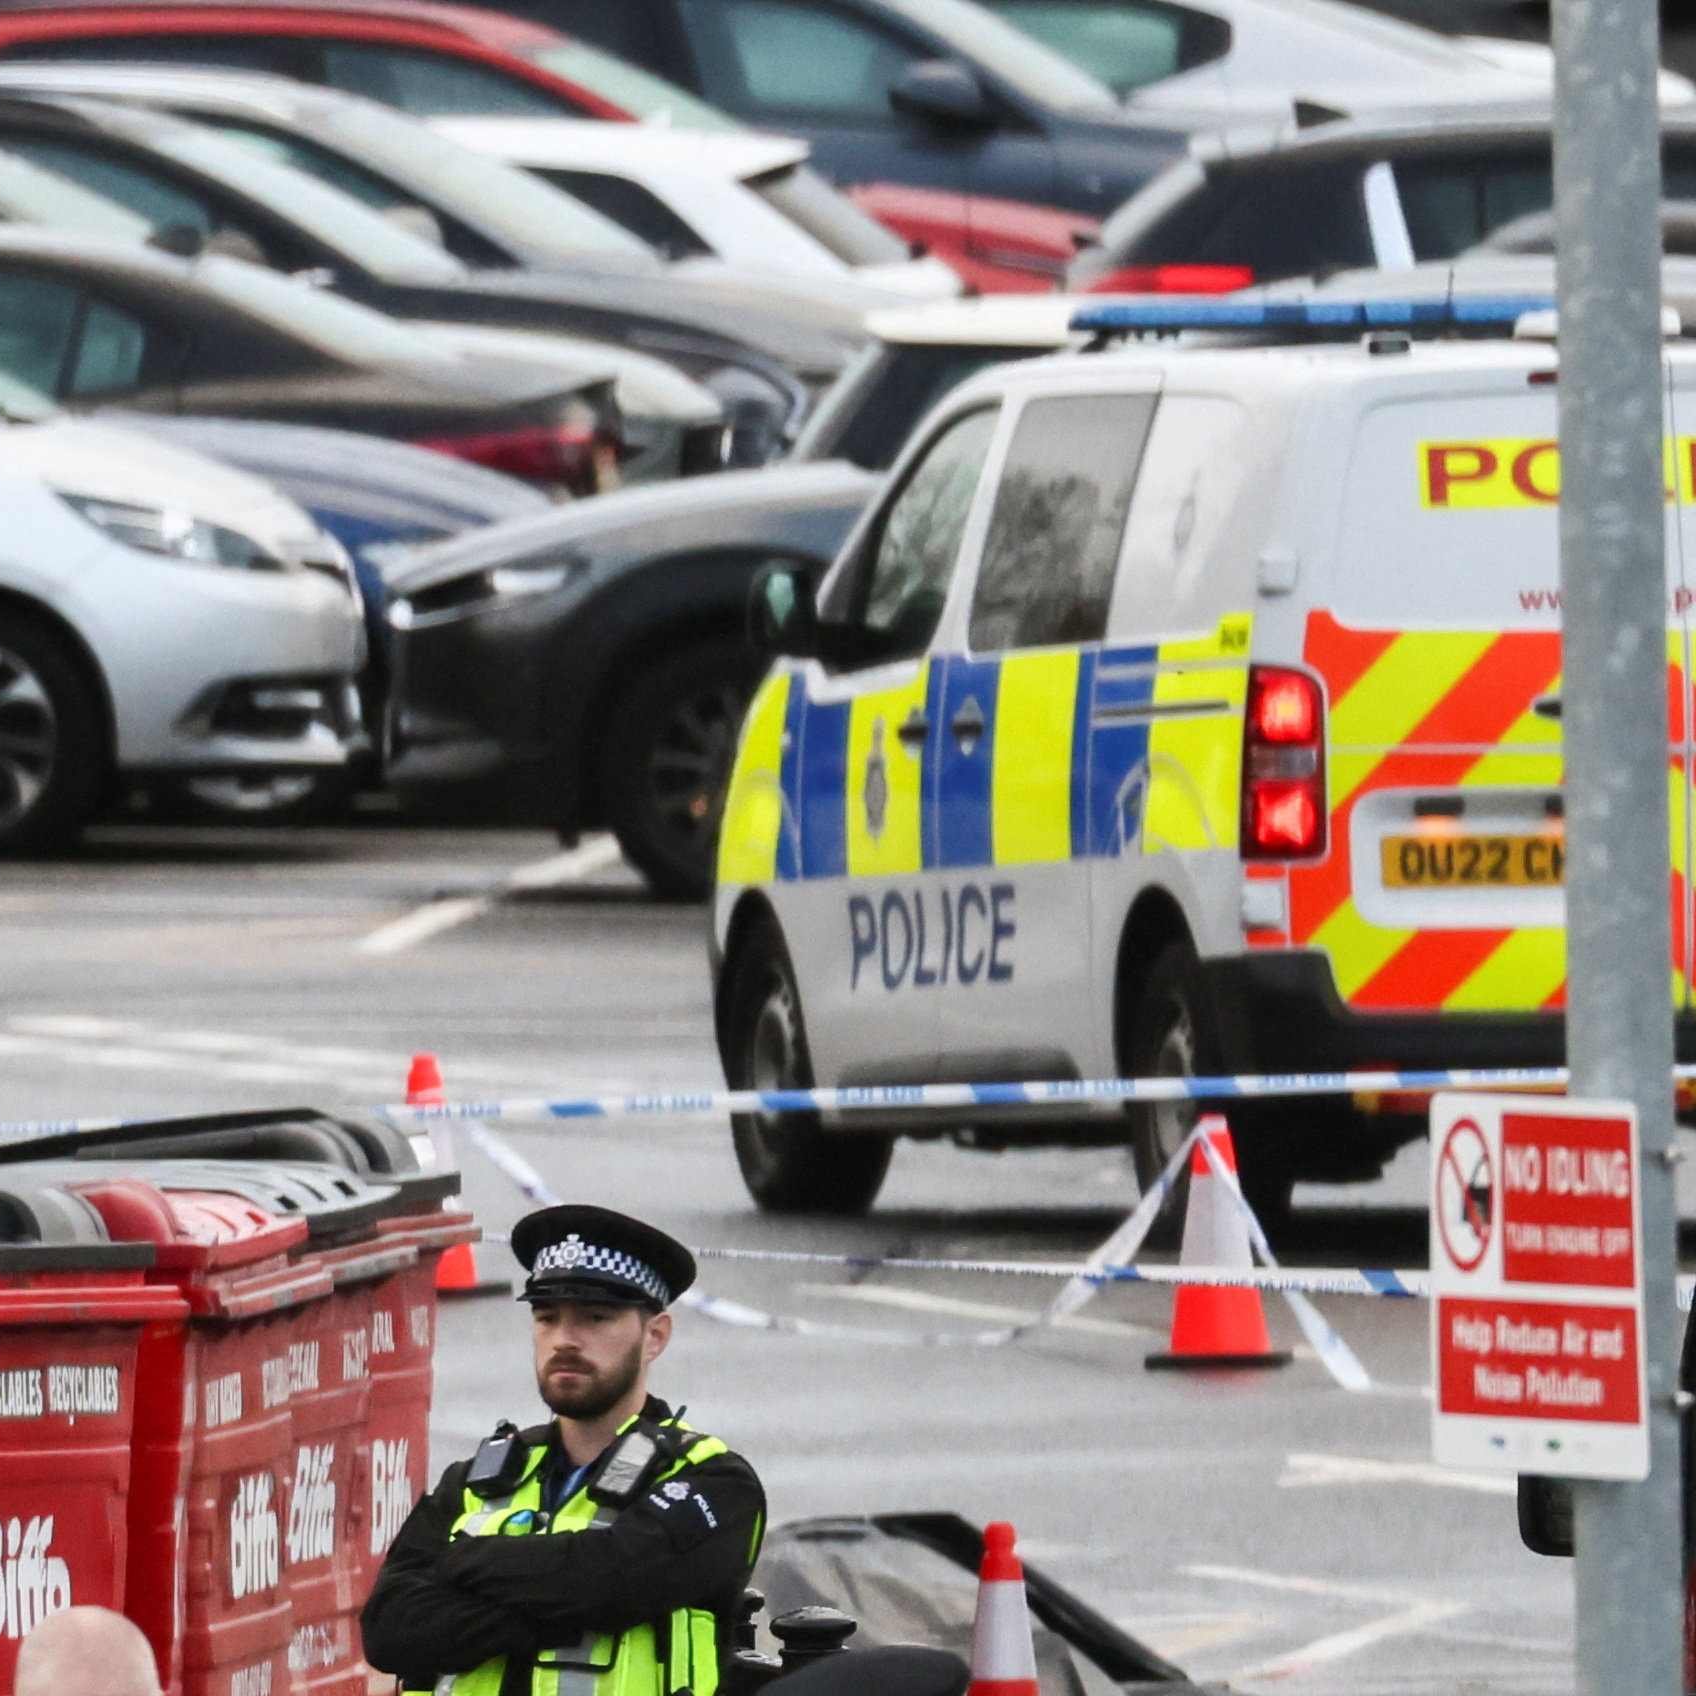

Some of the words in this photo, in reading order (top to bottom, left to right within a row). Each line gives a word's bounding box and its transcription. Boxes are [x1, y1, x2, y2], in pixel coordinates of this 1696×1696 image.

[847, 882, 1016, 991] POLICE
[1504, 1143, 1543, 1196] NO
[1545, 1145, 1630, 1199] IDLING
